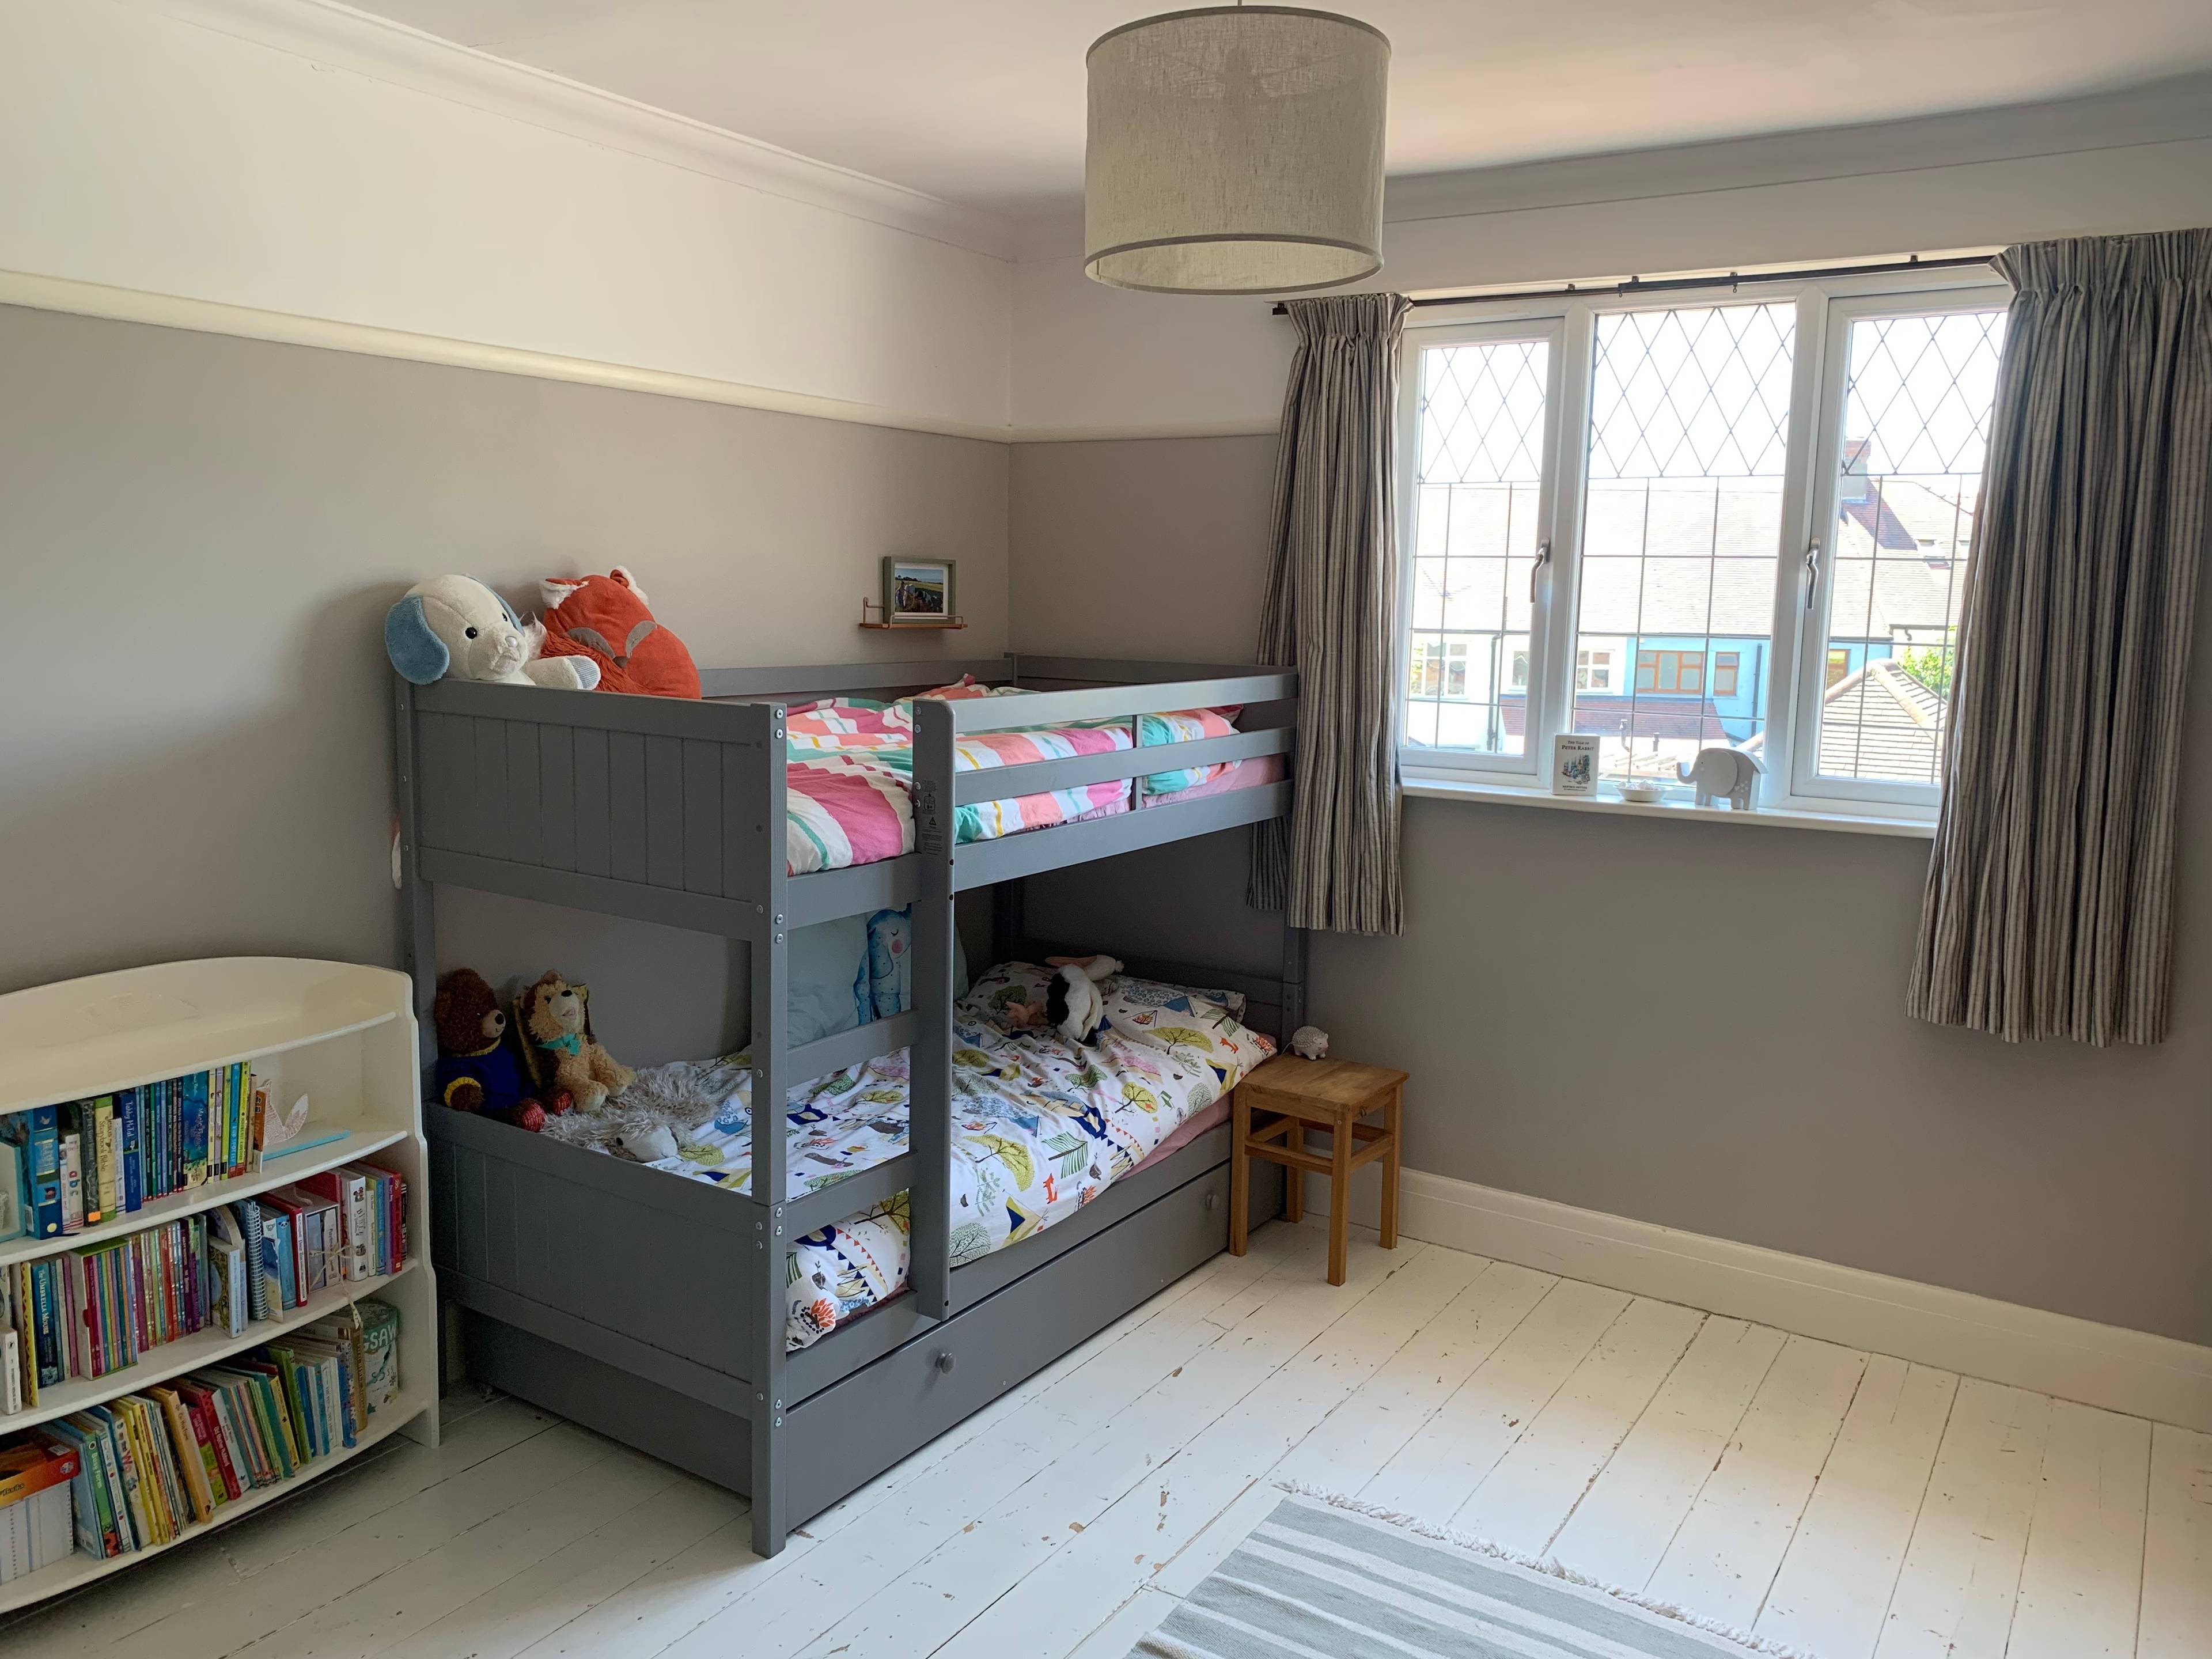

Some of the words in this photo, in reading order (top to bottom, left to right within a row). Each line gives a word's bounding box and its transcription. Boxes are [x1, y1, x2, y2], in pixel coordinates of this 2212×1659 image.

[96, 1120, 107, 1153] Storybook
[100, 1154, 108, 1172] Bible
[363, 1320, 396, 1353] GSAW
